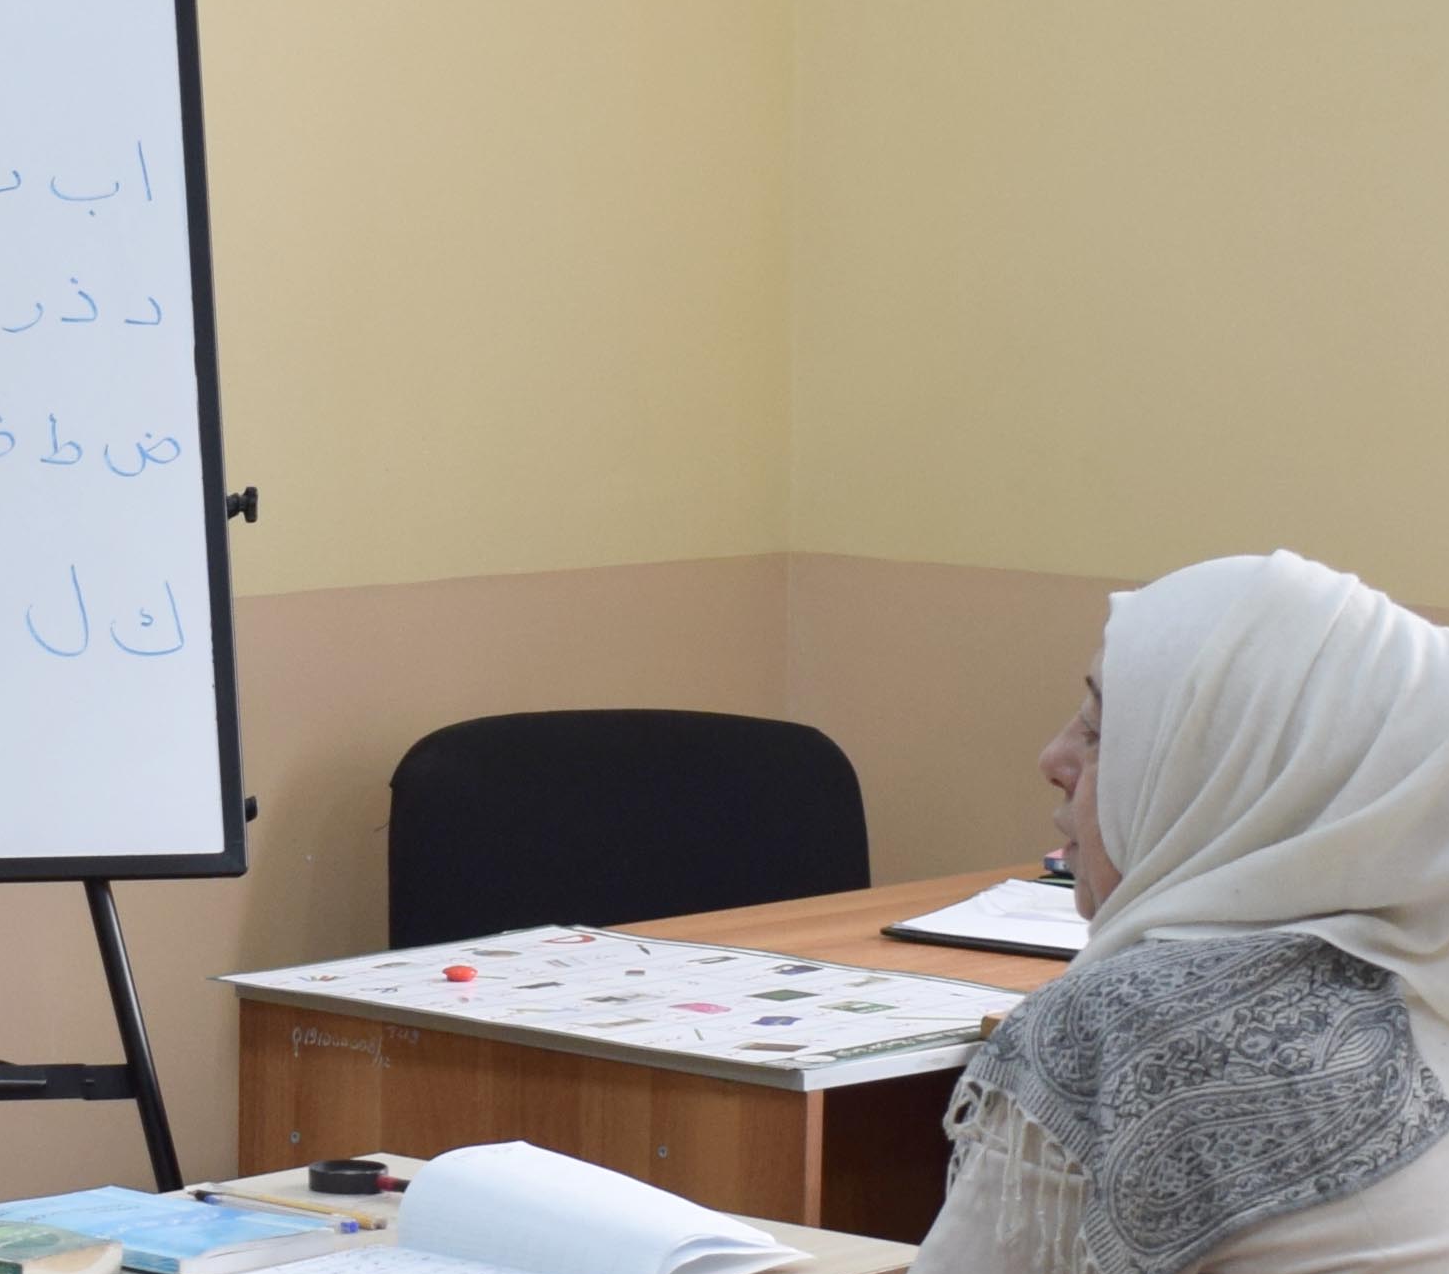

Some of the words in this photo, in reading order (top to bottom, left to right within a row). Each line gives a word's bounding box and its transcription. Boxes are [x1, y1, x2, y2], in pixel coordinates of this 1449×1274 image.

[49, 174, 120, 217] ب
[2, 299, 43, 333] ر
[59, 276, 99, 325] ذ
[124, 293, 163, 326] د
[40, 412, 83, 465] ط
[103, 431, 182, 478] ض
[25, 563, 91, 658] ل
[110, 579, 185, 657] ك
